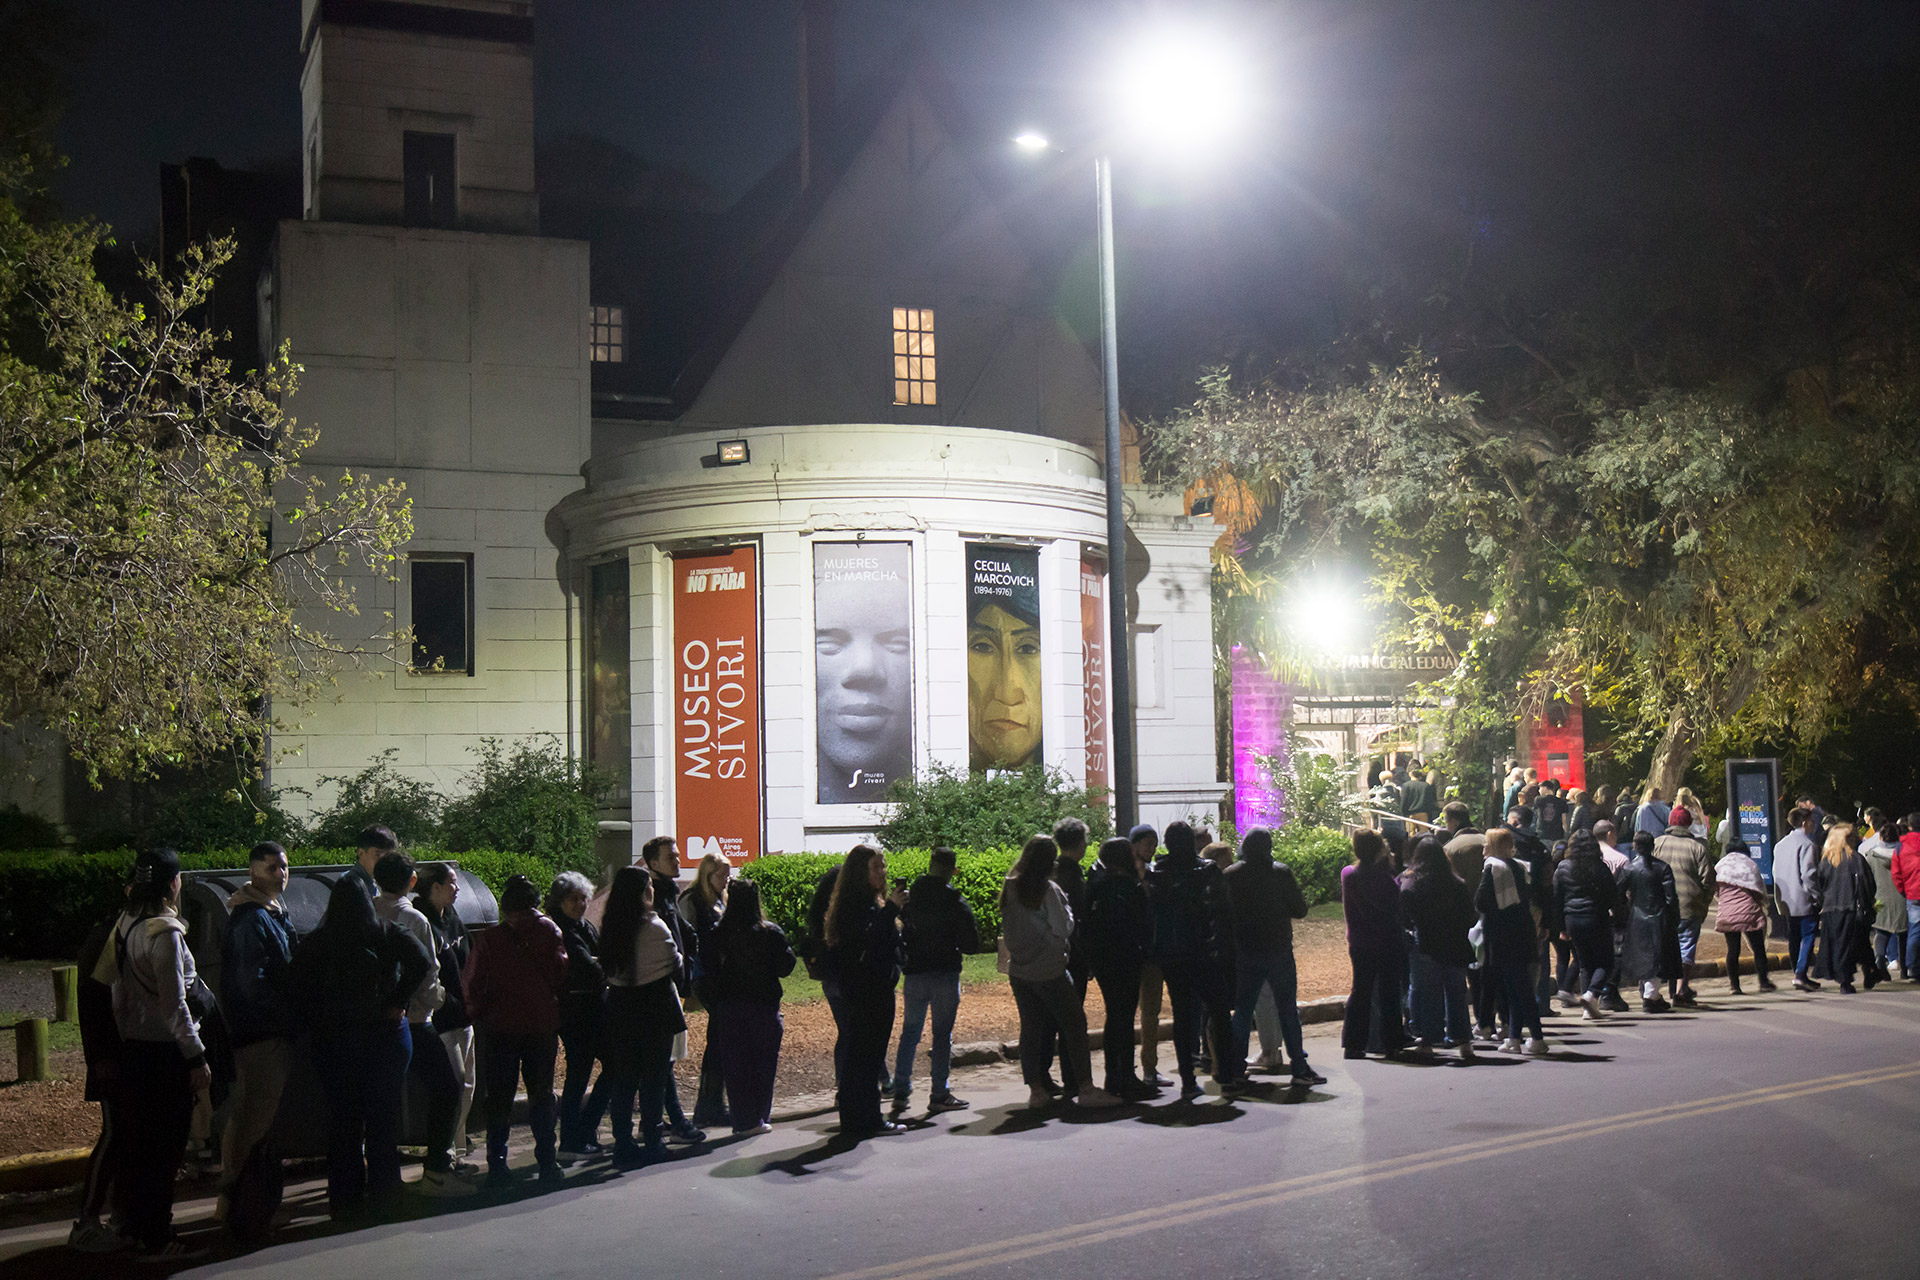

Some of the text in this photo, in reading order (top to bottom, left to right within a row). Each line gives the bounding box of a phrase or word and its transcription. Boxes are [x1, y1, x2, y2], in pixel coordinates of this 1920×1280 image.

[824, 558, 879, 569] MUJERES
[974, 560, 1012, 573] CECILIA
[825, 570, 899, 581] EN MARCHA
[974, 573, 1034, 587] MARCOVICH
[687, 572, 746, 593] NO PARA
[974, 586, 1012, 597] (1894-1976)
[683, 640, 711, 779] MUSEO
[710, 636, 746, 779] SÍVORI
[1089, 640, 1104, 772] SÍVORI
[1739, 804, 1761, 812] NOCHE
[1741, 814, 1768, 824] MUSEOS
[687, 835, 724, 860] BA
